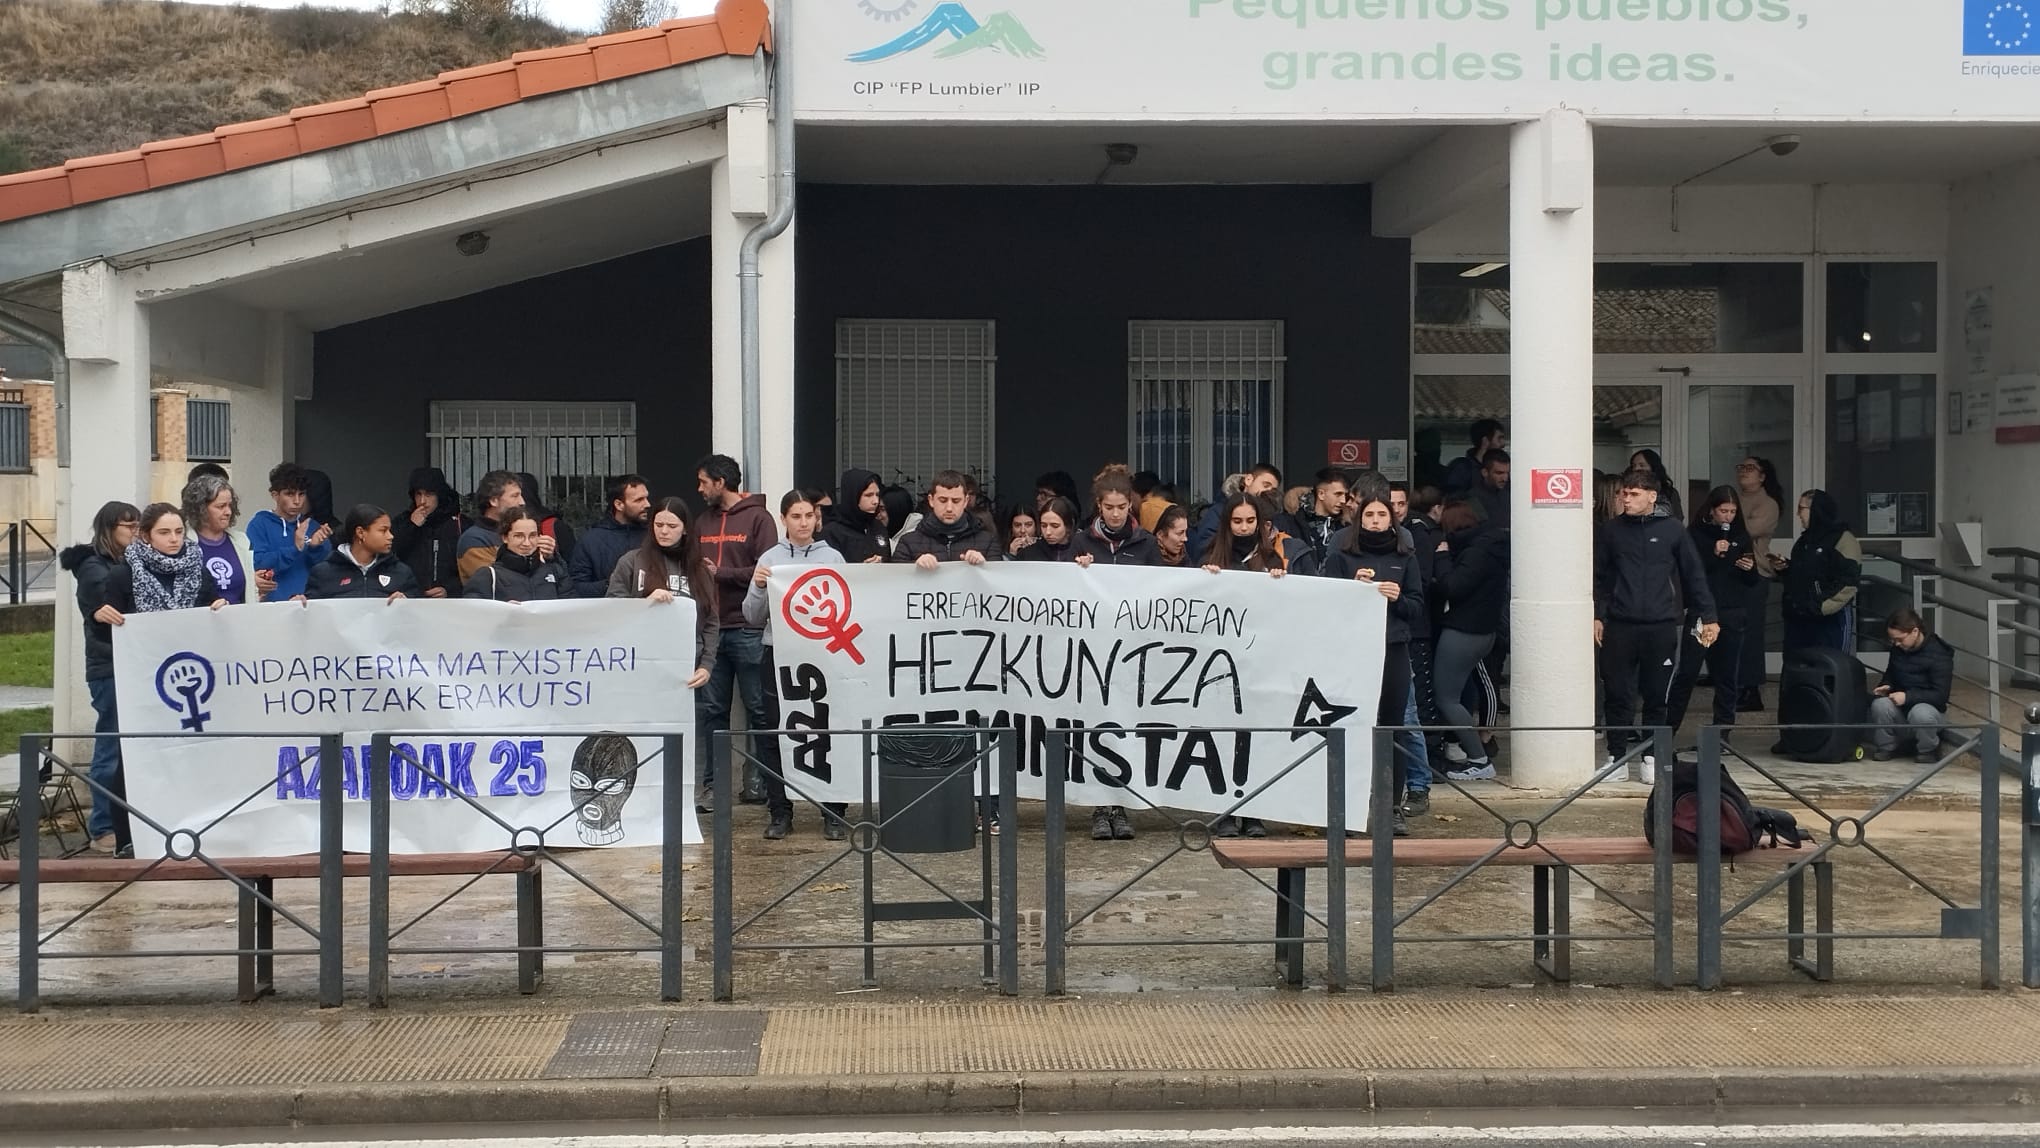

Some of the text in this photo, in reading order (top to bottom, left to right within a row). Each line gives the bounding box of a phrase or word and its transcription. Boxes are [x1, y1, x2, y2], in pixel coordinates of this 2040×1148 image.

[853, 81, 884, 95] CIP
[1018, 82, 1040, 96] IIP
[1262, 42, 1734, 90] grandes ideas.
[907, 592, 1256, 650] ERREAKZIOAREN AURREAN,
[226, 647, 636, 686] INDARKERIA MATXISTARI
[889, 630, 1243, 715] HEZKUNTZA
[264, 681, 591, 715] HORTZAK ERAKUTSI
[779, 663, 831, 784] A25
[489, 739, 547, 797] 25
[882, 709, 1252, 798] MINISTA!
